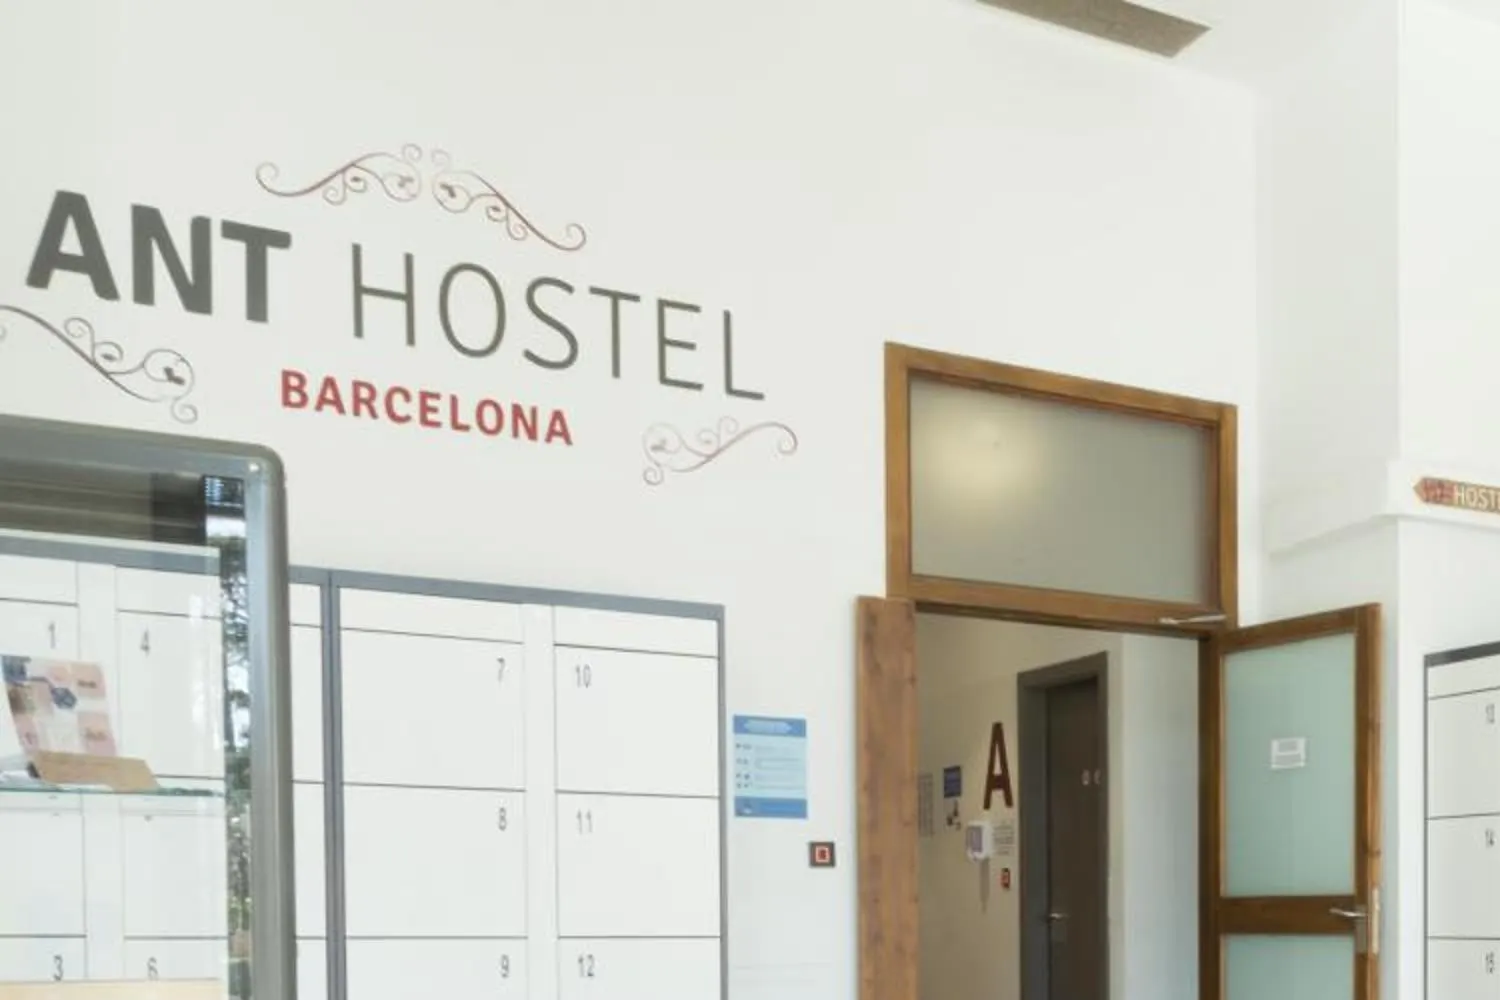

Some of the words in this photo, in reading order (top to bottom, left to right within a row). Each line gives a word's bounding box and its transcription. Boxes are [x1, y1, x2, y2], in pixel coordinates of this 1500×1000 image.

[25, 189, 293, 324] ANT
[351, 243, 765, 401] HOSTEL
[280, 368, 573, 446] BARCELONA
[139, 630, 151, 655] 4
[496, 657, 506, 681] 7
[574, 663, 592, 689] 10
[983, 722, 1014, 810] A
[575, 809, 593, 834] 11
[53, 954, 65, 982] 3
[577, 953, 595, 979] 12
